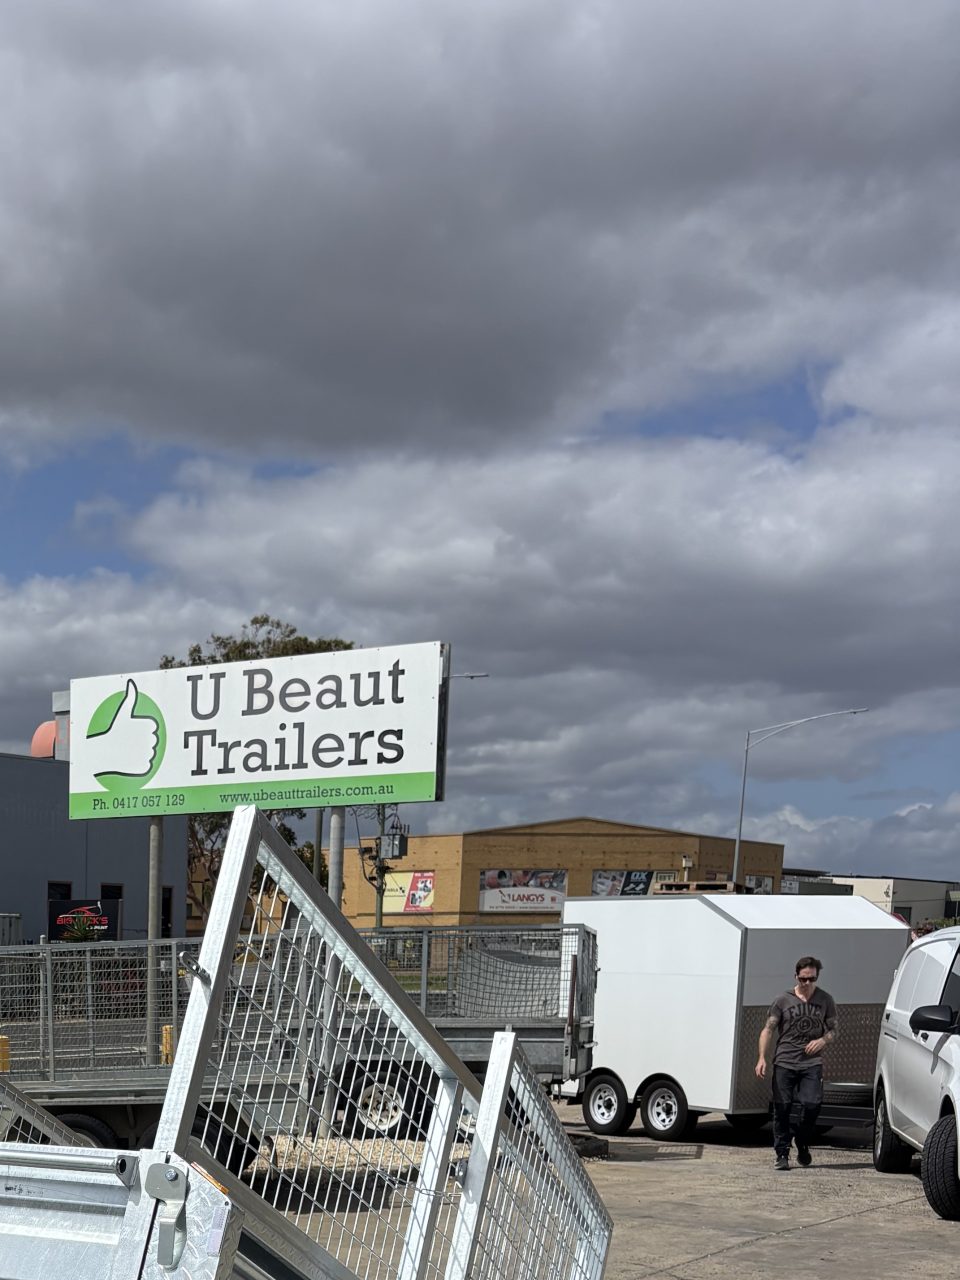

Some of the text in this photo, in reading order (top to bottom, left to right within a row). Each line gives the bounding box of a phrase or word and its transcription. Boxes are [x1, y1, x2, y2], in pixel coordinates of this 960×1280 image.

[187, 659, 405, 720] U Beaut
[183, 722, 404, 776] Trailers
[92, 794, 185, 811] Ph. 0417 057 129
[219, 784, 394, 803] www.ubeauttrailers.com.au
[512, 893, 545, 902] LANGYS
